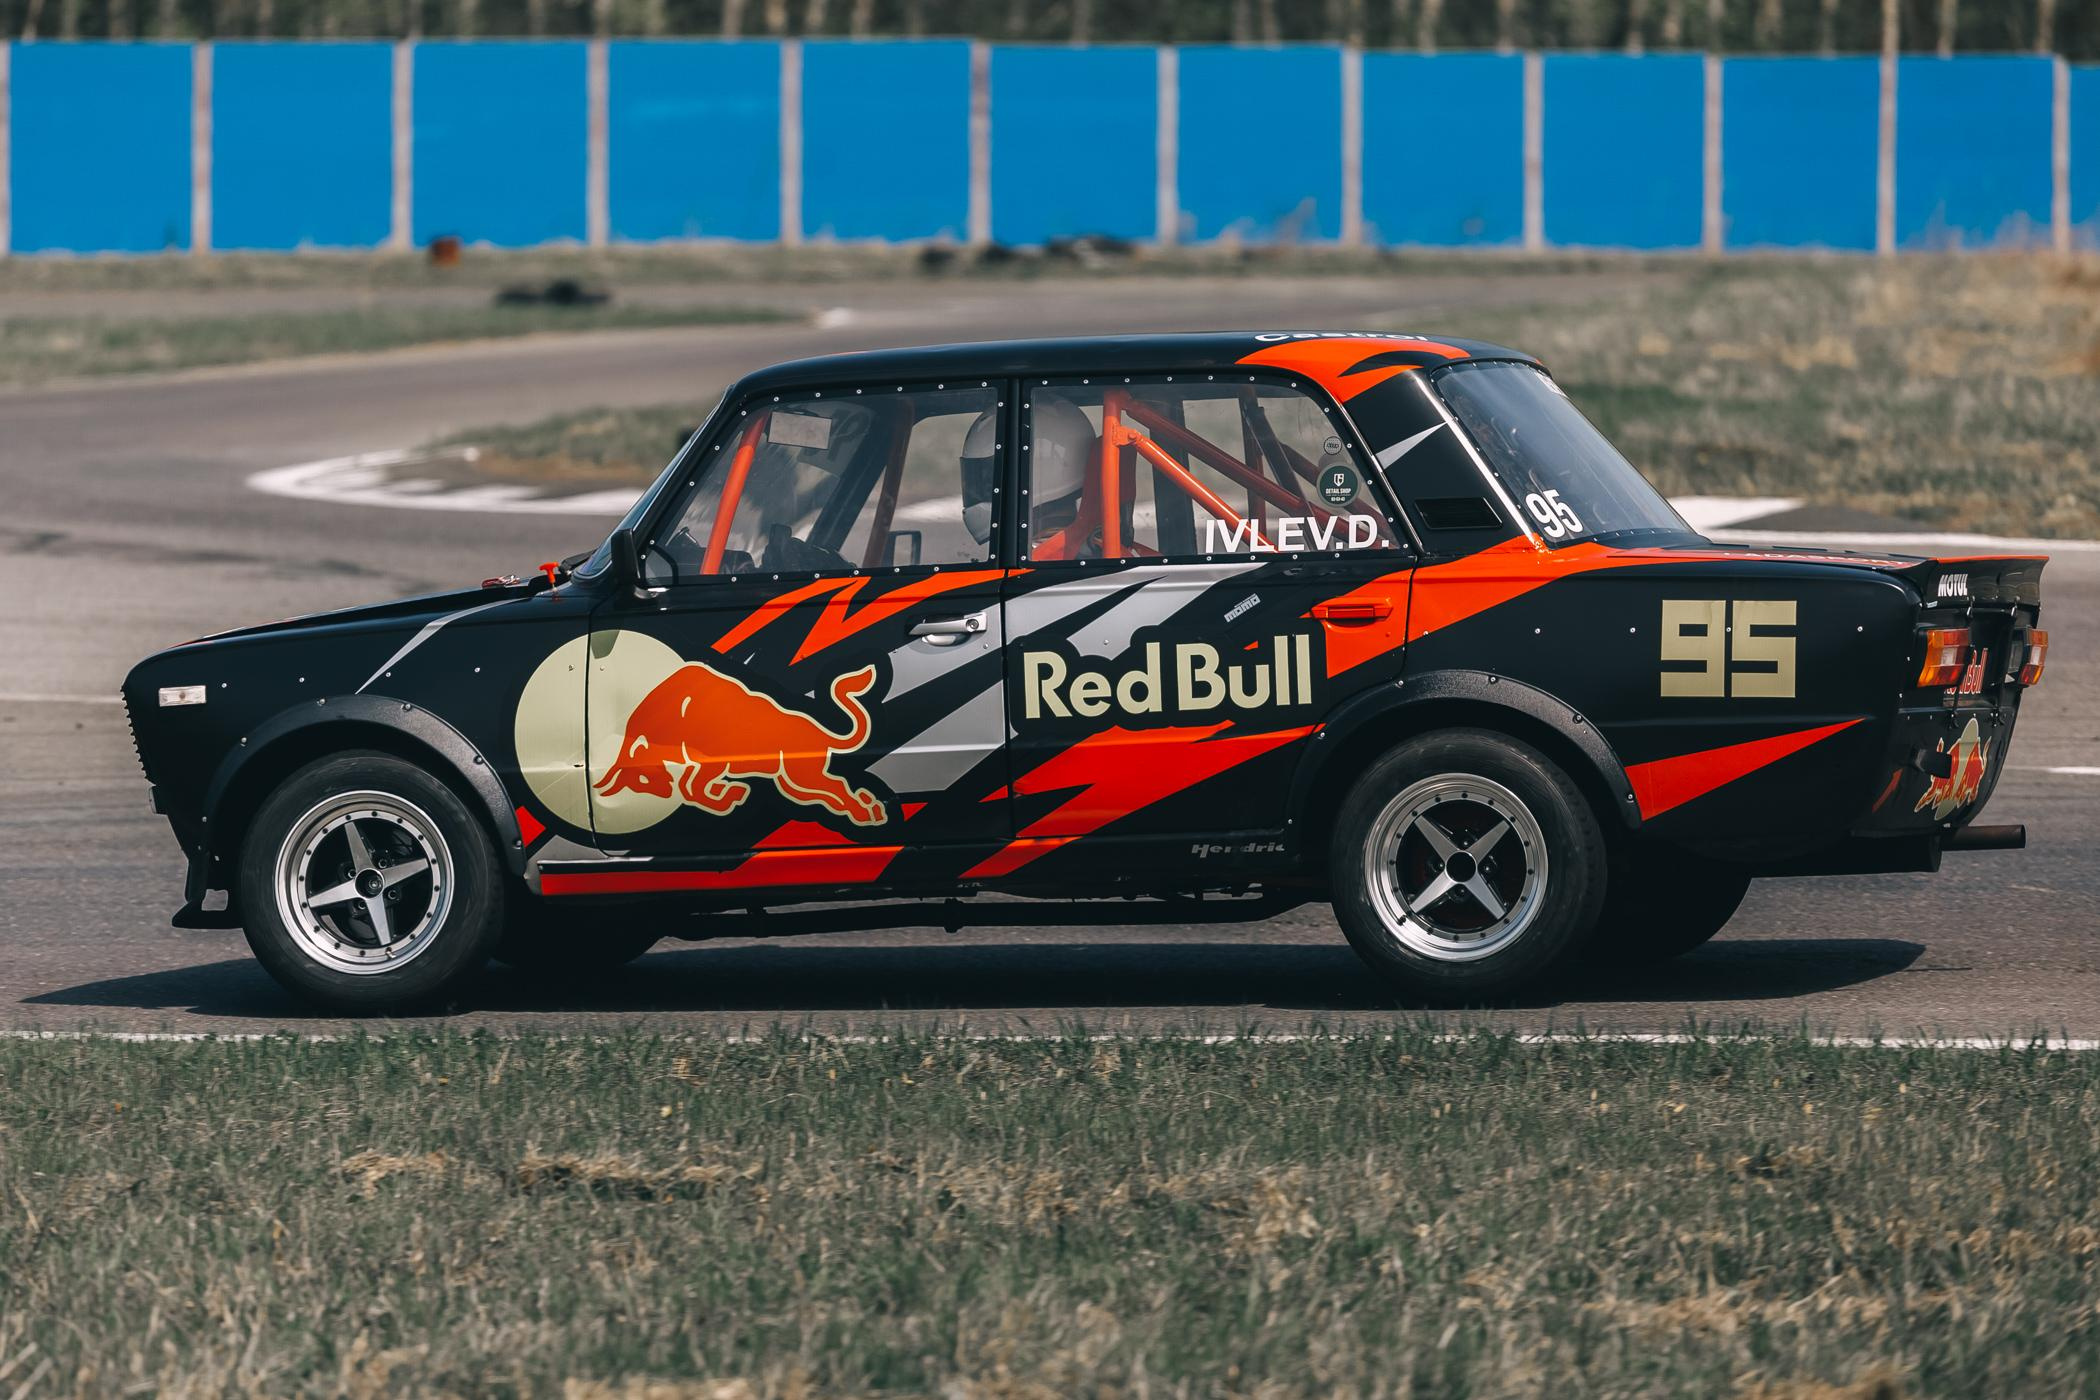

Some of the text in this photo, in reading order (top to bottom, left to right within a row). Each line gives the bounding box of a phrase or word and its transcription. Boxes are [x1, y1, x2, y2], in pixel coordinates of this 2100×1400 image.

[1205, 514, 1390, 553] IVLEV.D.
[1525, 489, 1584, 538] 95
[1938, 573, 1969, 597] MOTUL
[1660, 599, 1798, 698] 95
[1023, 633, 1312, 719] Red Bull
